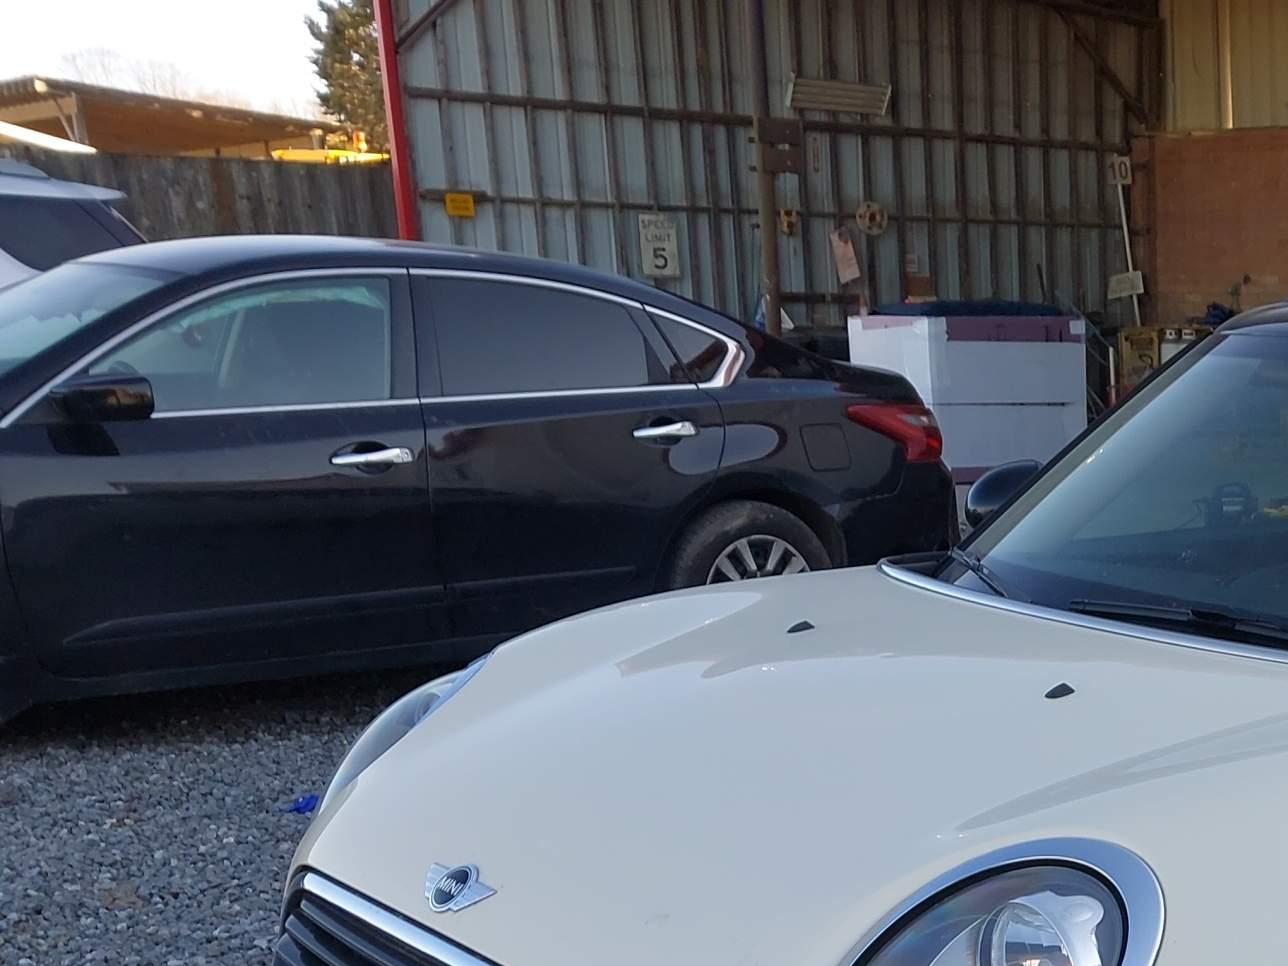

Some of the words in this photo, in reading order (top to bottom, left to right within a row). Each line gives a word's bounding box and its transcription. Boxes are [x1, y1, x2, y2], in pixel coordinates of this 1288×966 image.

[1110, 161, 1129, 180] 10
[645, 232, 671, 242] LIMIT
[653, 248, 668, 269] 5
[437, 876, 465, 896] MINI
